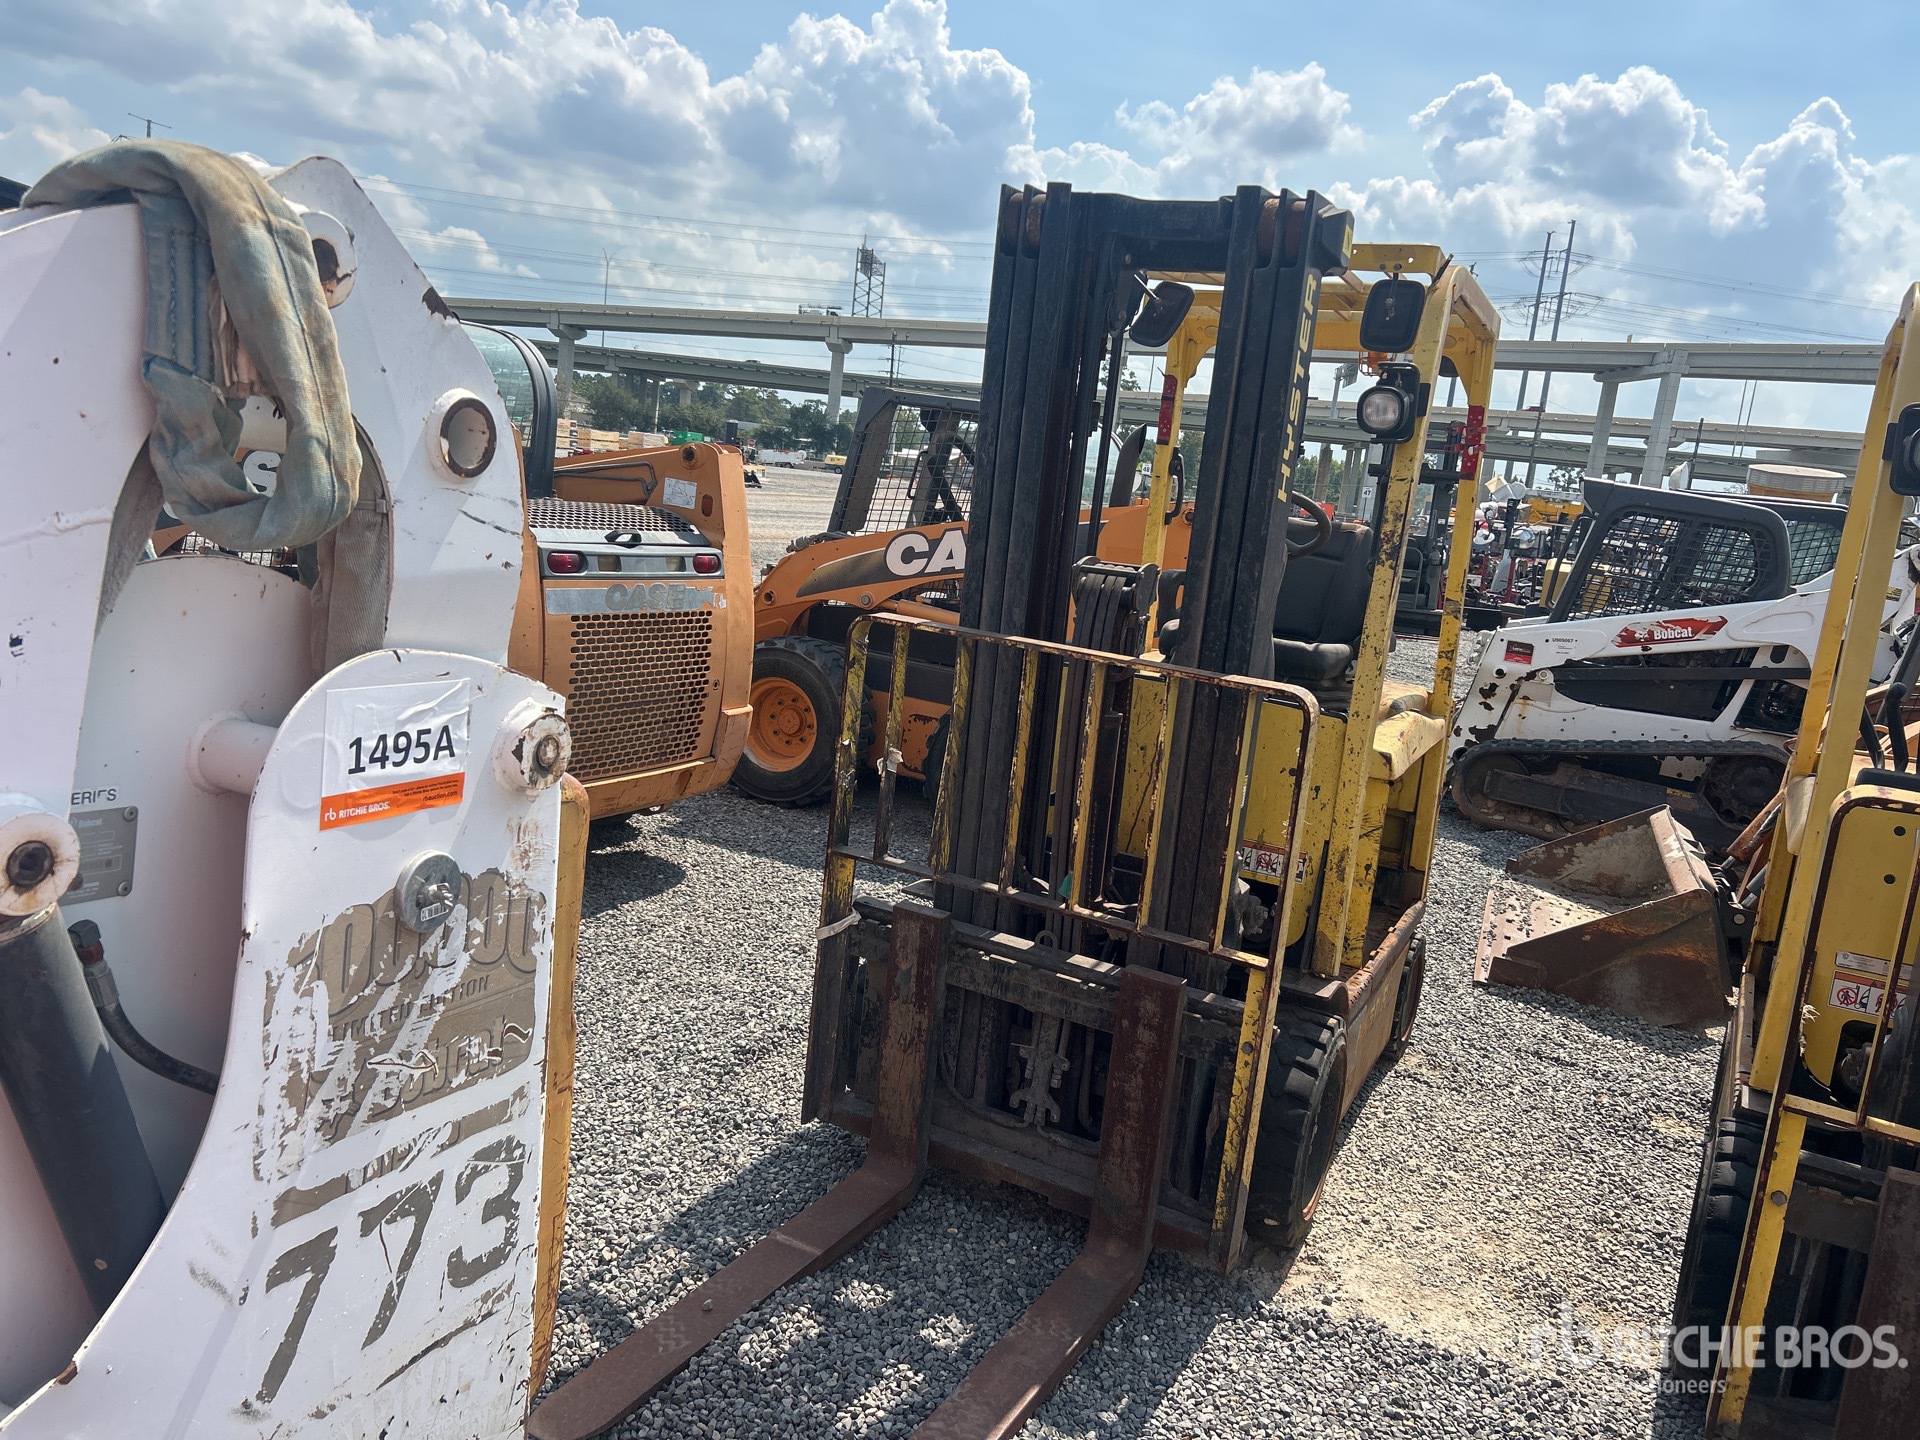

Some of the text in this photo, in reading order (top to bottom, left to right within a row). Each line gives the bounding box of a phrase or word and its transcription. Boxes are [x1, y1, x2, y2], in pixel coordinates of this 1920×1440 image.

[1277, 273, 1317, 503] HYSTER
[605, 583, 686, 611] CASE
[1654, 626, 1692, 641] Bobcat
[348, 724, 455, 775] 1495A
[422, 790, 458, 802] rbauction.com
[338, 805, 367, 819] RITCHIE
[255, 1134, 527, 1404] 773
